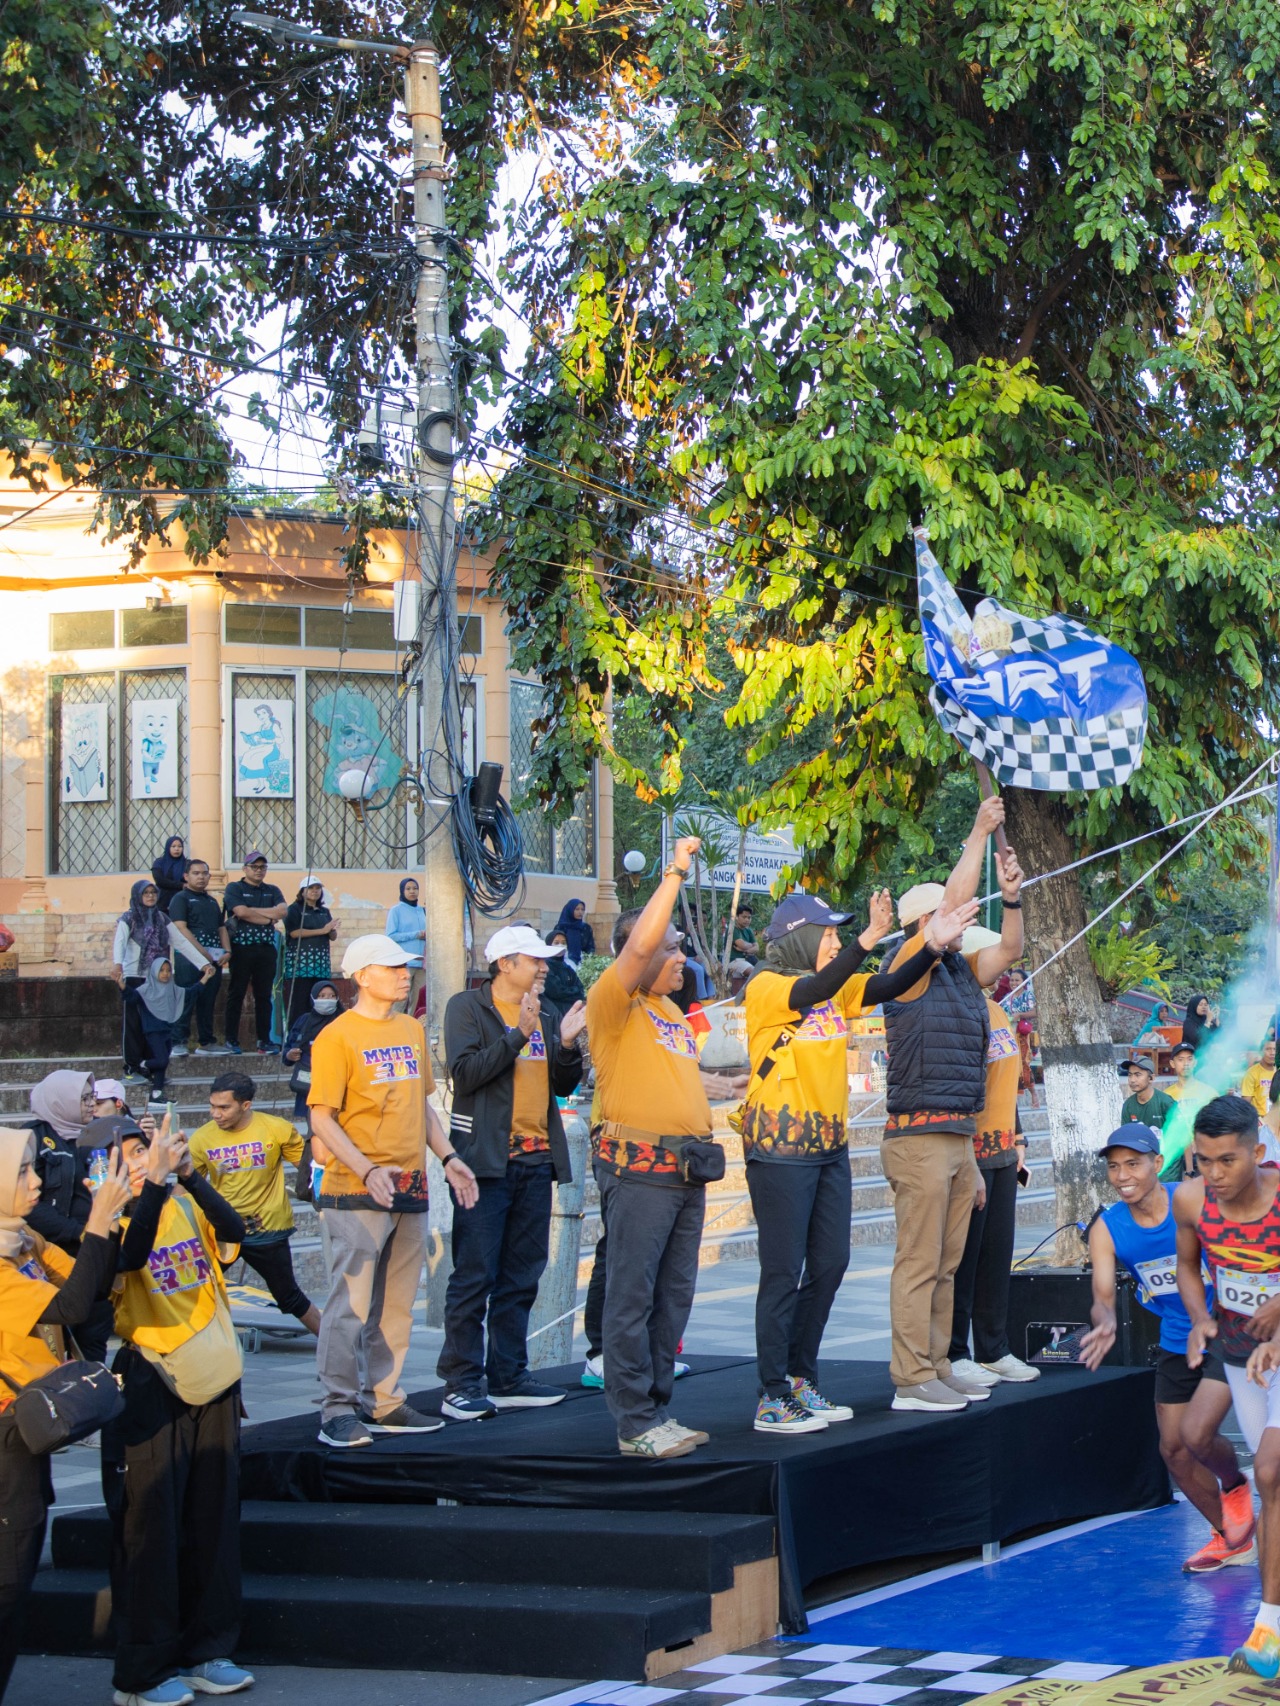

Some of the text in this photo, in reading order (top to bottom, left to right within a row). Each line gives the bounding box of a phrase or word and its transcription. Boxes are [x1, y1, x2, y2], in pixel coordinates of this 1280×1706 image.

[741, 856, 788, 870] ASYARAKAT
[363, 1045, 414, 1065] MMTB
[520, 1042, 545, 1057] UN
[378, 1060, 419, 1077] RUN
[207, 1141, 263, 1161] MMTB
[222, 1153, 266, 1171] RUN
[148, 1237, 205, 1271] MTB
[1225, 1287, 1279, 1307] 020
